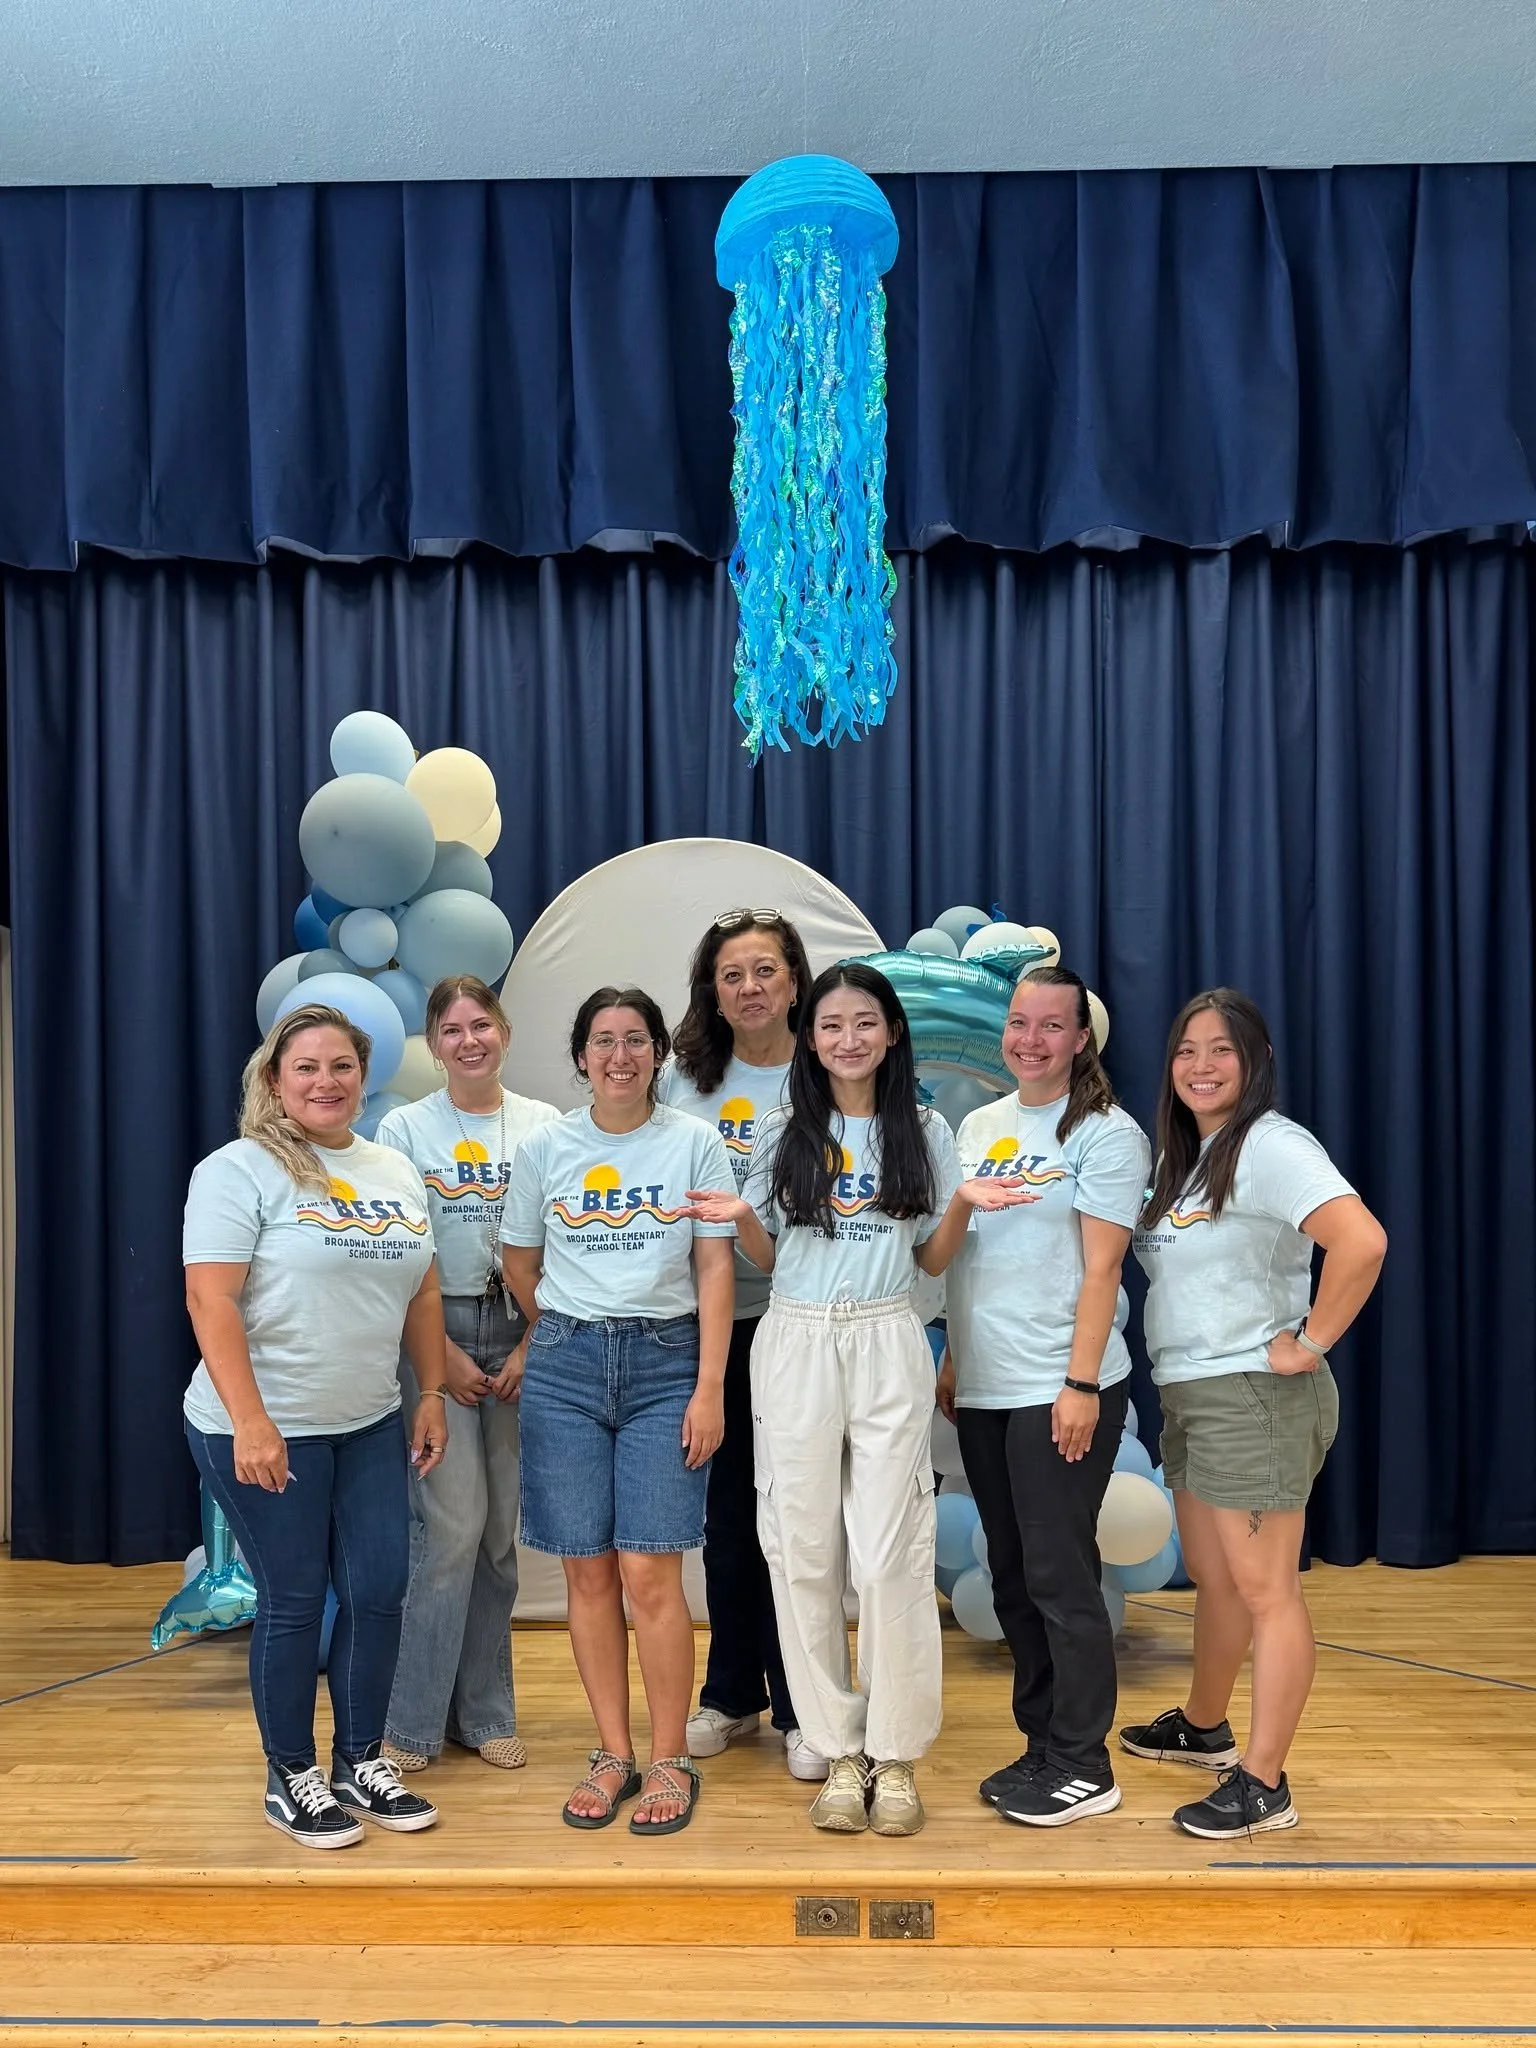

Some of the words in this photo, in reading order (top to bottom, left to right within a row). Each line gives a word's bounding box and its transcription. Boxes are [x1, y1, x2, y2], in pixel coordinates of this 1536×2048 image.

[582, 1184, 664, 1211] B.E.S.T.
[330, 1196, 409, 1220] B.E.S.T.
[442, 1205, 484, 1214] BROADWAY
[840, 1221, 895, 1234] ELEMENTARY
[566, 1233, 609, 1243] BROADWAY
[611, 1230, 666, 1242] ELEMENTARY
[813, 1229, 846, 1240] SCHOL
[848, 1231, 872, 1242] TEAM
[324, 1236, 370, 1249] BROADWAY
[373, 1240, 421, 1250] ELEMENTARY
[586, 1242, 620, 1252] SCHOOL
[622, 1241, 645, 1251] TEAM
[348, 1249, 379, 1259] SCHOOL
[382, 1251, 403, 1260] TEAM
